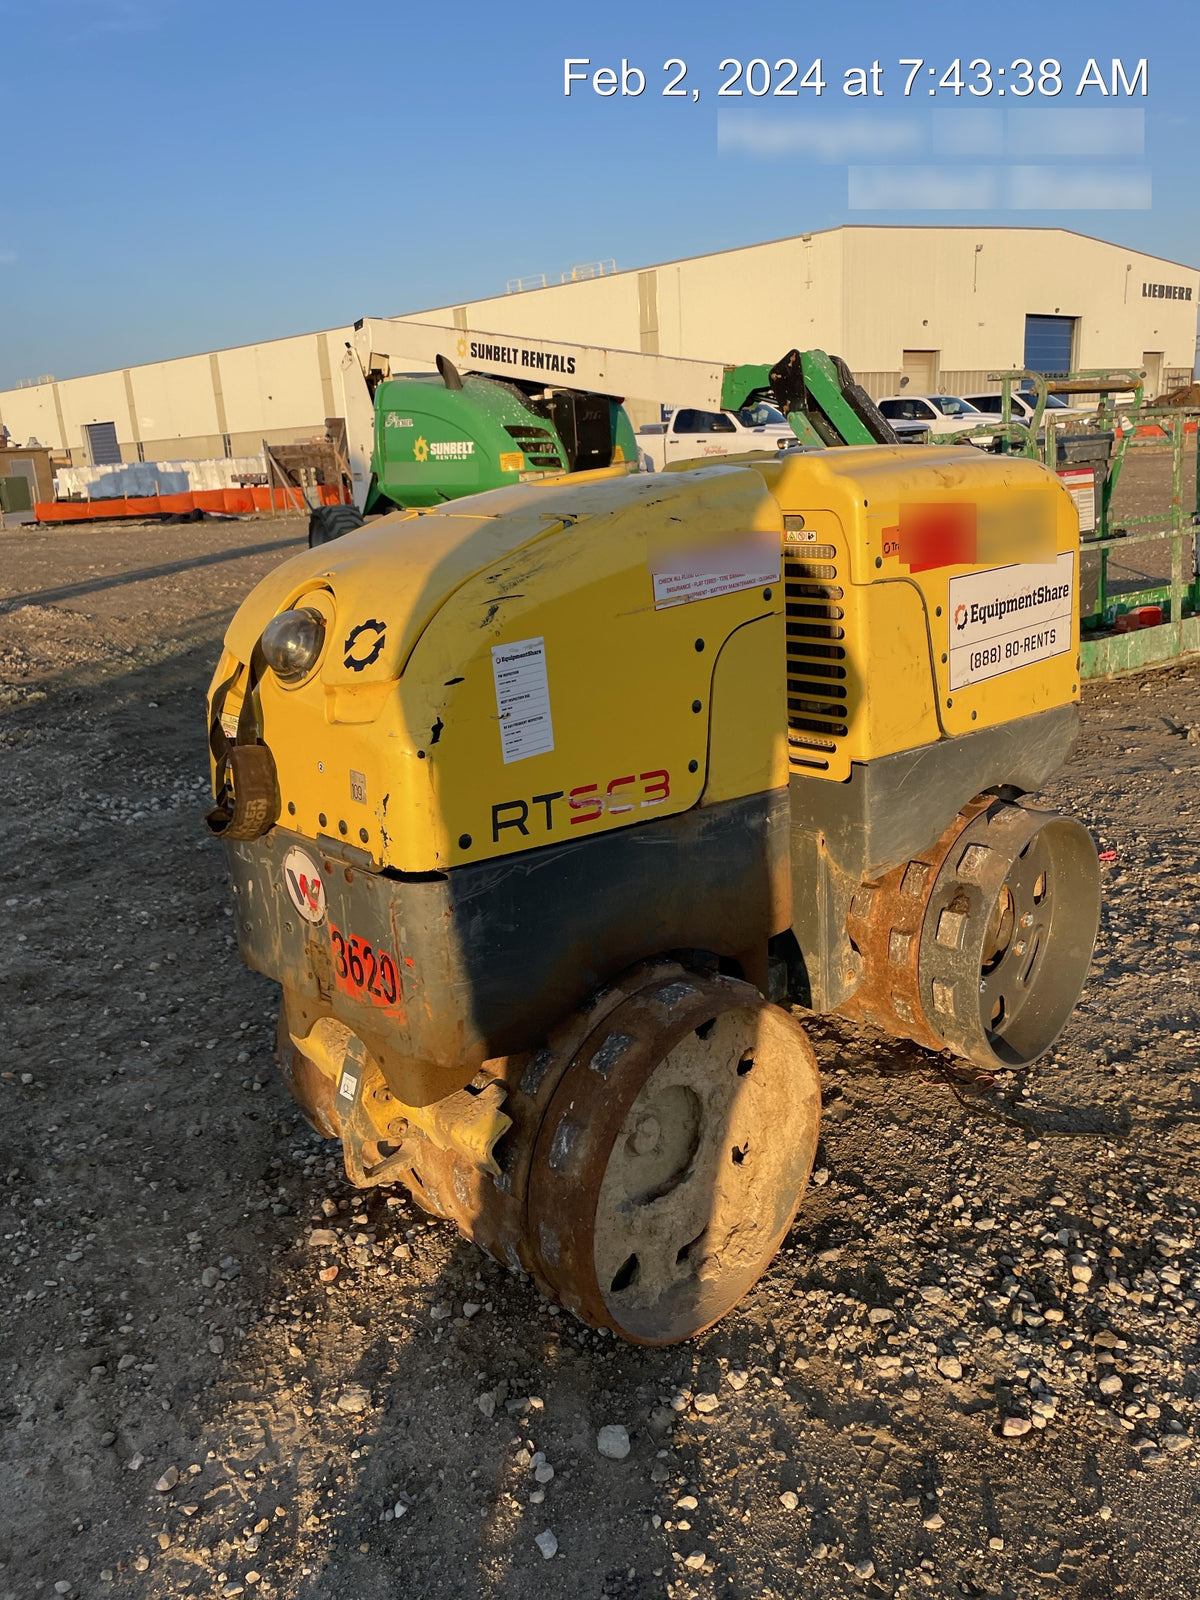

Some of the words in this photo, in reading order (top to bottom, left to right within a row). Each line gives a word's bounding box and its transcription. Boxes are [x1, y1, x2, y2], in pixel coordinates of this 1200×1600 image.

[1142, 283, 1193, 301] LIEBHERR
[470, 342, 519, 365] SUNBELT
[521, 349, 576, 374] RENTALS
[430, 441, 474, 455] SUNBELT
[970, 584, 1069, 624] EquipmentShare
[501, 650, 542, 662] EquipmentShare
[970, 644, 1002, 671] (888)
[1005, 629, 1056, 659] 80-RENTS
[331, 930, 397, 1004] 3620
